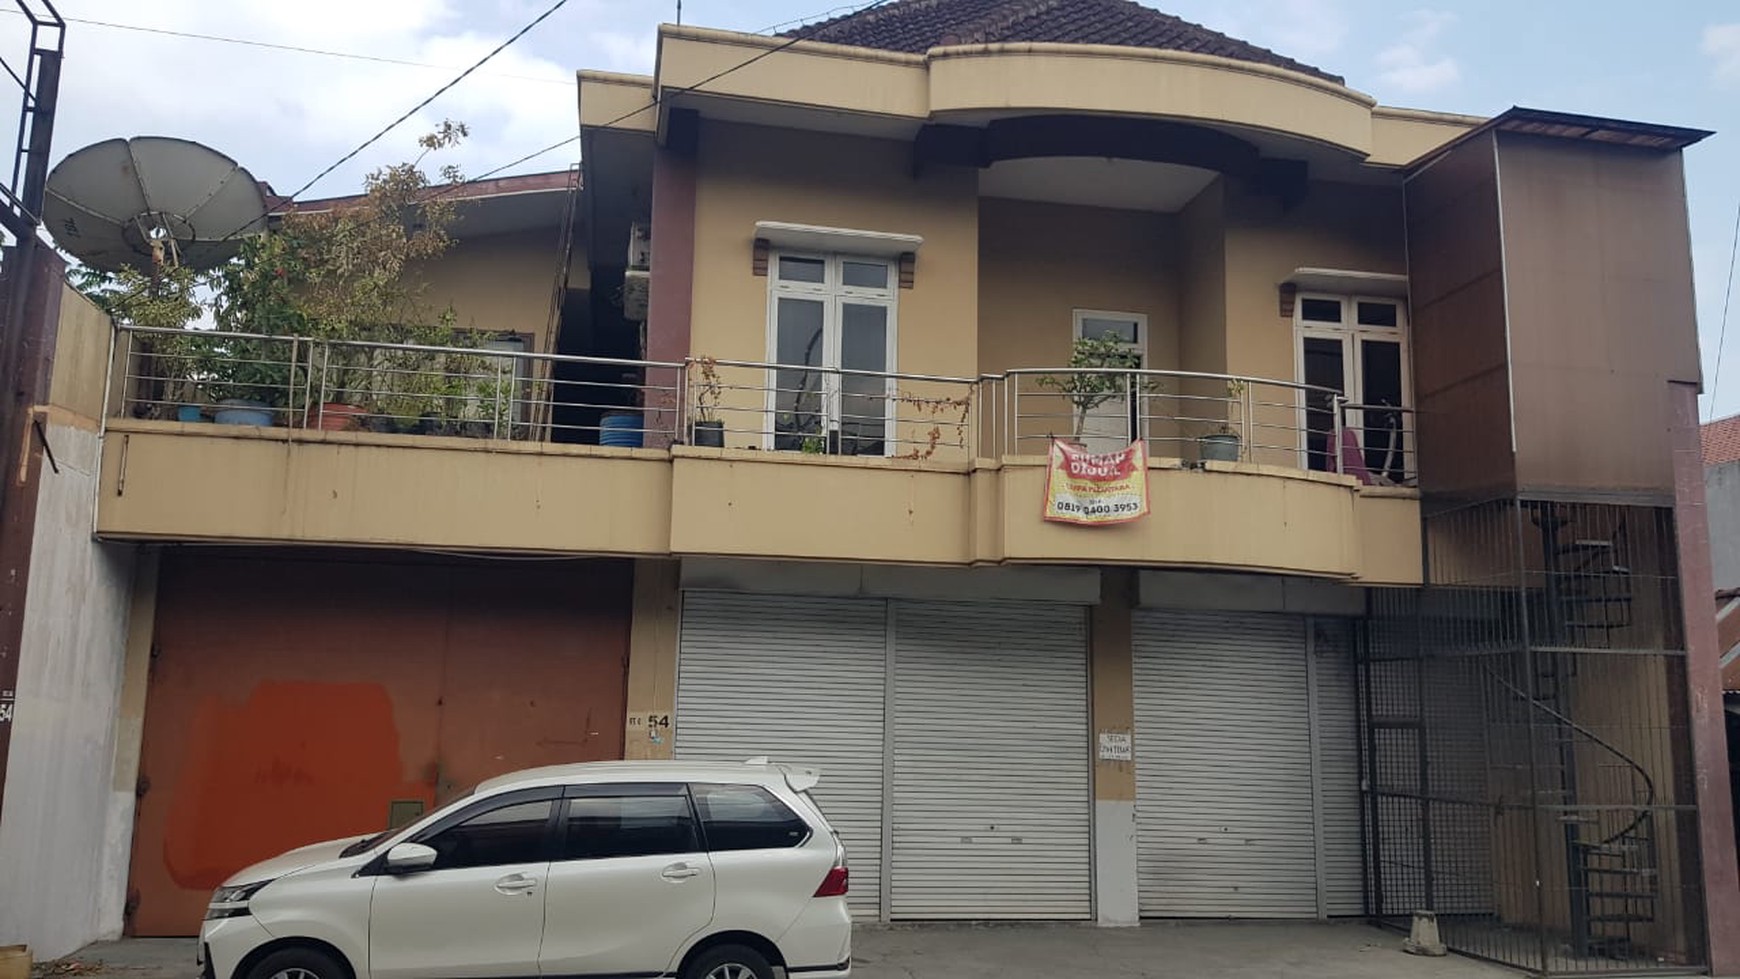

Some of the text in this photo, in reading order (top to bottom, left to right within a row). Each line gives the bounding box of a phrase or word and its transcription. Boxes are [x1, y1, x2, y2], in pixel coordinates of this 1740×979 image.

[1057, 502, 1138, 515] 0819 0400 3953
[0, 703, 13, 722] 54
[648, 715, 669, 728] 54
